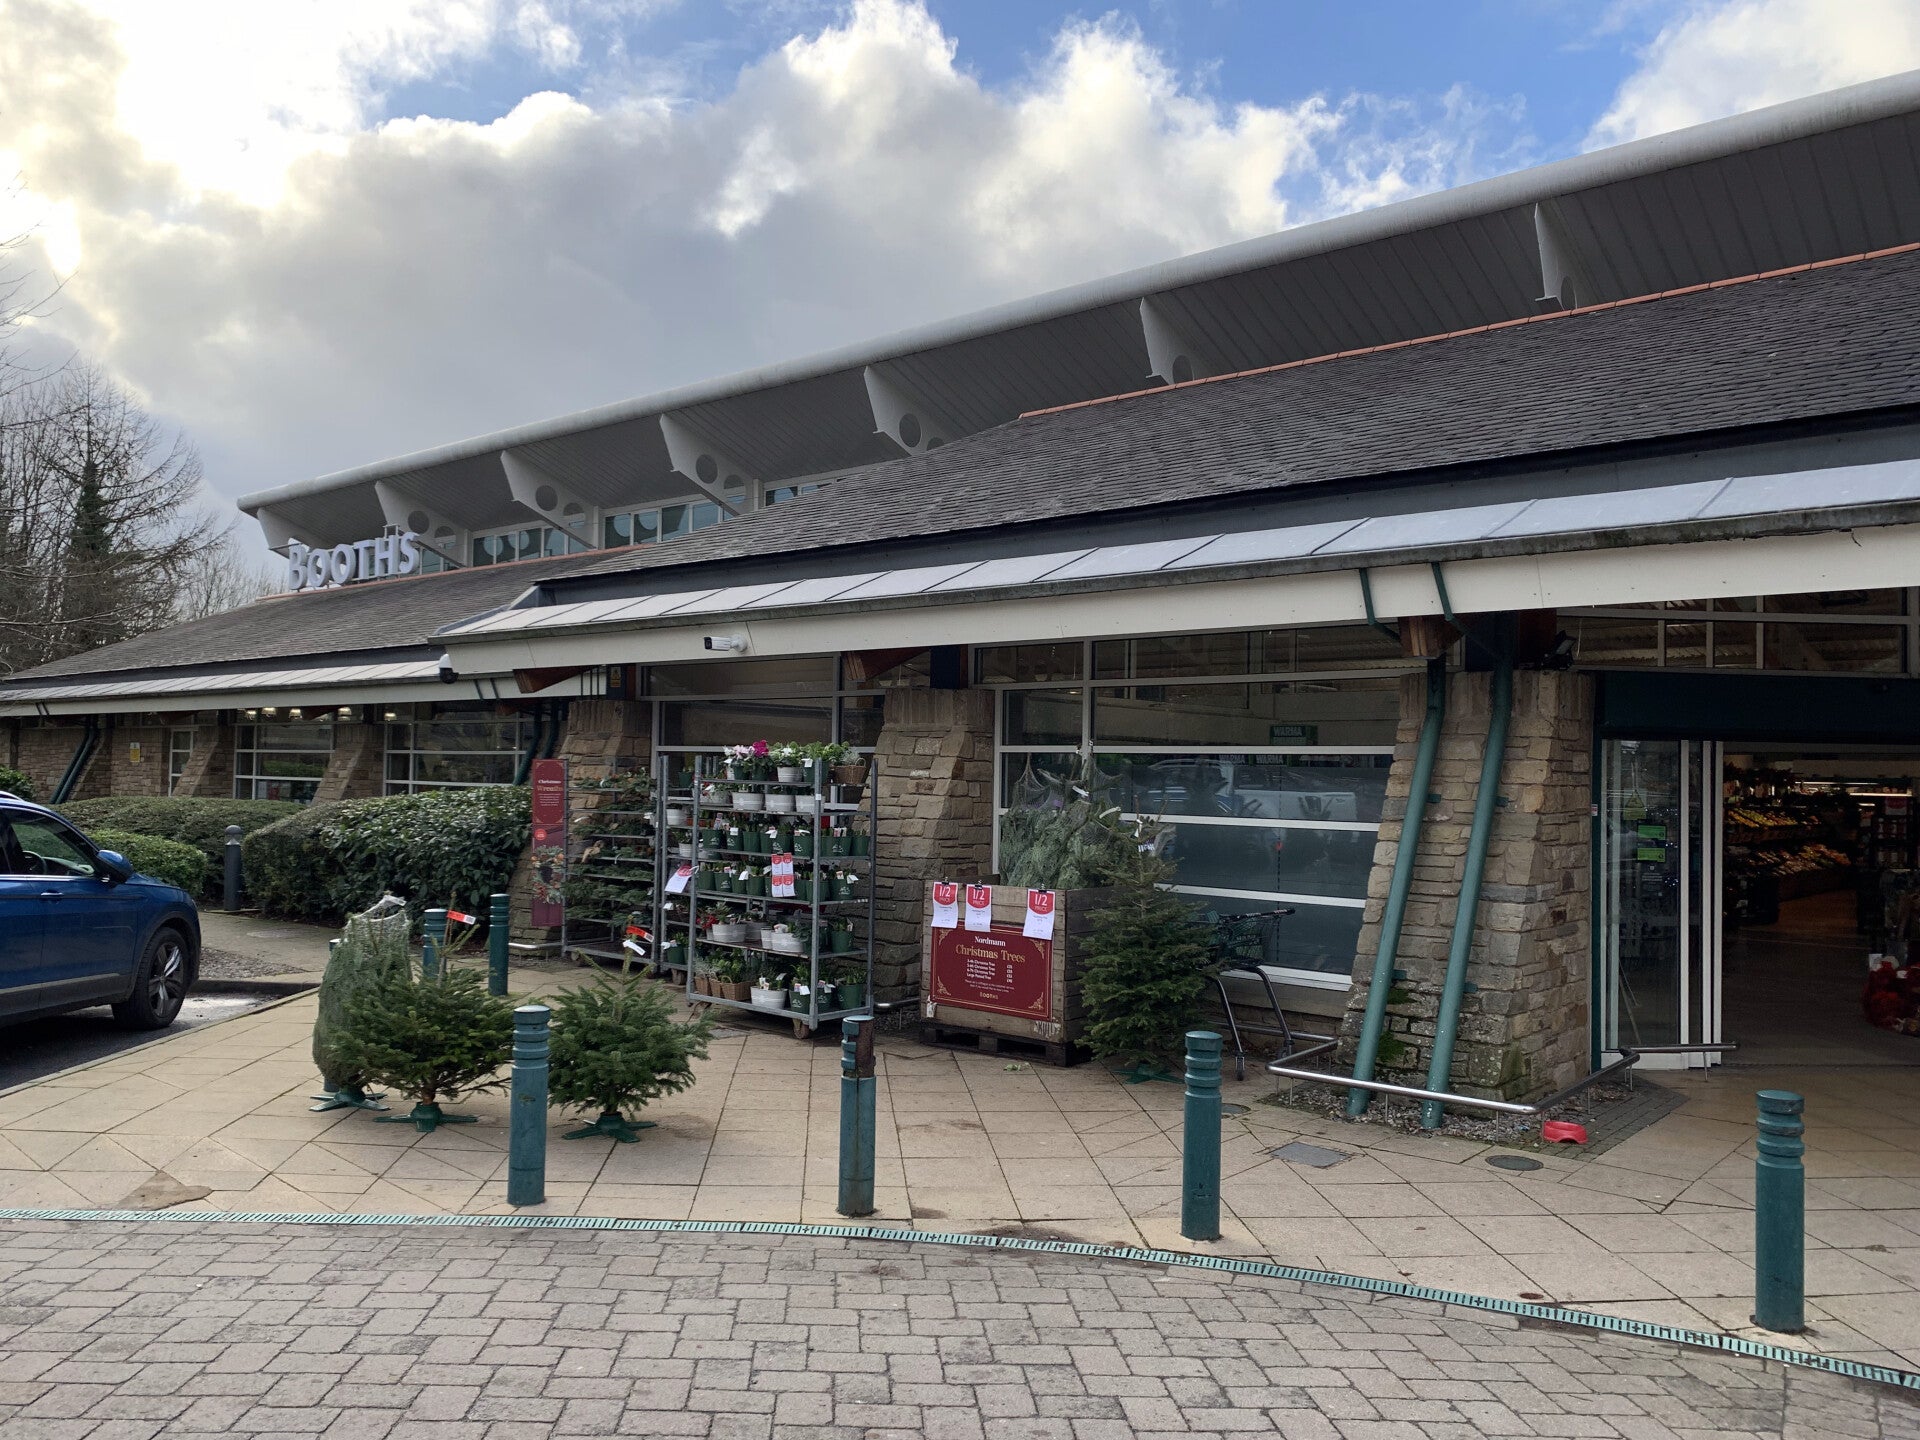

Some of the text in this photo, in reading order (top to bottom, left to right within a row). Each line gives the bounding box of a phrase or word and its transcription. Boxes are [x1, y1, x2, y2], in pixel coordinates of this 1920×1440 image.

[288, 532, 420, 590] BOOTHS
[939, 885, 951, 897] 1/2
[972, 888, 985, 900] 1/2
[1034, 894, 1048, 906] 1/2
[974, 935, 1006, 947] Nordmann
[955, 944, 1026, 963] Christmas Trees
